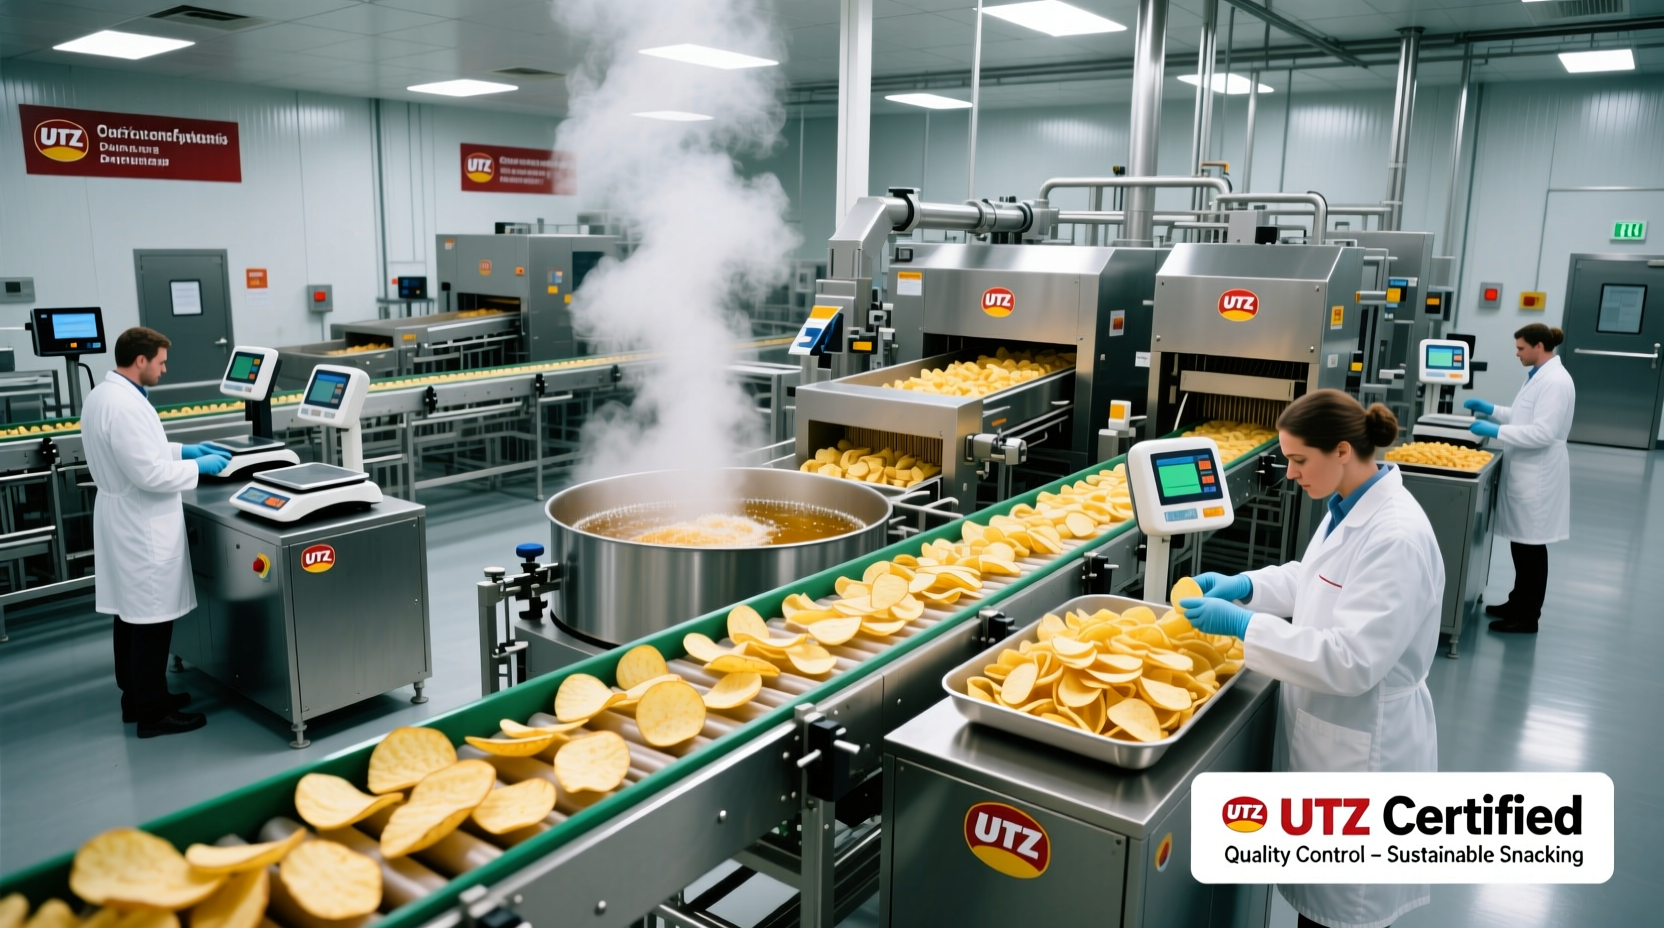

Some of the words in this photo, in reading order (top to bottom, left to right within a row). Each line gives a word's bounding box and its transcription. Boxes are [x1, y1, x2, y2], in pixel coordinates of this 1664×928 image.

[41, 127, 83, 147] UTZ
[467, 158, 492, 172] UTZ
[985, 293, 1012, 307] UTZ
[1223, 294, 1254, 310] UTZ
[305, 550, 332, 564] UTZ
[974, 811, 1043, 860] UTZ
